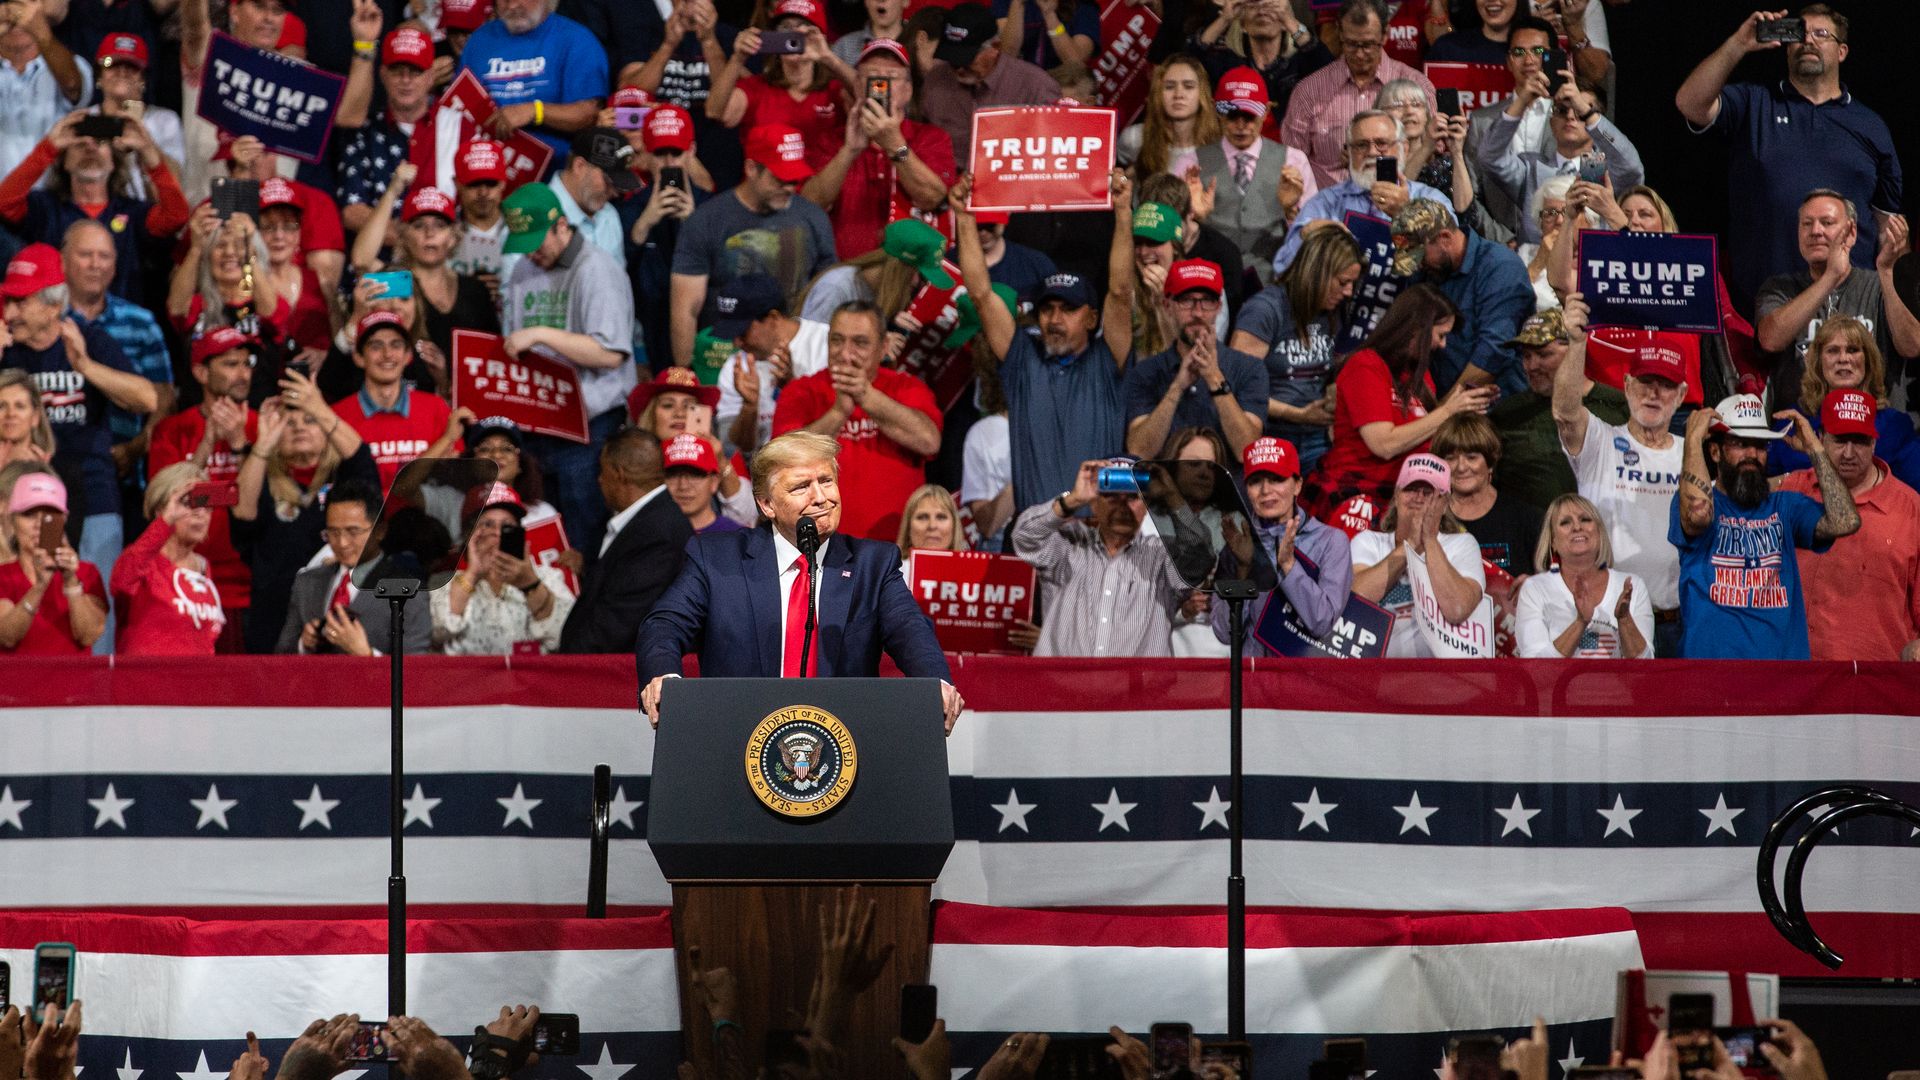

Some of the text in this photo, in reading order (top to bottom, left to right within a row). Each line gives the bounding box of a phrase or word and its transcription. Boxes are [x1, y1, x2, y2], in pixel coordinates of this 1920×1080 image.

[1093, 14, 1145, 86] RUMP
[214, 60, 328, 113] TRUMP
[217, 83, 312, 127] PENCE
[982, 136, 1102, 157] TRUMP
[990, 158, 1090, 173] PENCE
[1018, 174, 1049, 182] AMERICA
[1588, 260, 1707, 283] TRUMP
[1350, 241, 1388, 340] PENCE
[1597, 282, 1696, 297] PENCE
[1606, 297, 1625, 305] KEEP
[1662, 299, 1689, 307] GREAT!
[1641, 353, 1661, 361] GREAT
[1657, 348, 1682, 360] AMERICA
[463, 356, 574, 395] TRUMP
[474, 377, 568, 406] PENCE
[1843, 393, 1864, 403] KEEP
[1737, 409, 1762, 418] 2020
[1834, 402, 1871, 416] AMERICA
[1838, 410, 1866, 422] GREAT
[370, 440, 429, 456] RUMP
[1255, 437, 1277, 448] KEEP
[1248, 446, 1286, 460] AMERICA
[1251, 454, 1280, 465] GREAT
[1408, 458, 1446, 473] TRUMP
[1616, 466, 1680, 485] TRUM
[1716, 521, 1784, 557] TRUMP
[1715, 567, 1743, 588] MAKE
[920, 579, 1027, 604] TRUMP
[1710, 582, 1789, 608] GREAT AGAIN!
[929, 602, 1015, 620] PENCE
[955, 620, 982, 628] AMERICA
[1283, 620, 1349, 659] KEEP AMERICA GREA
[1437, 629, 1479, 656] TRUMP
[750, 710, 854, 812] SEAL OF THE PRESIDENT OF THE UNITED STATES
